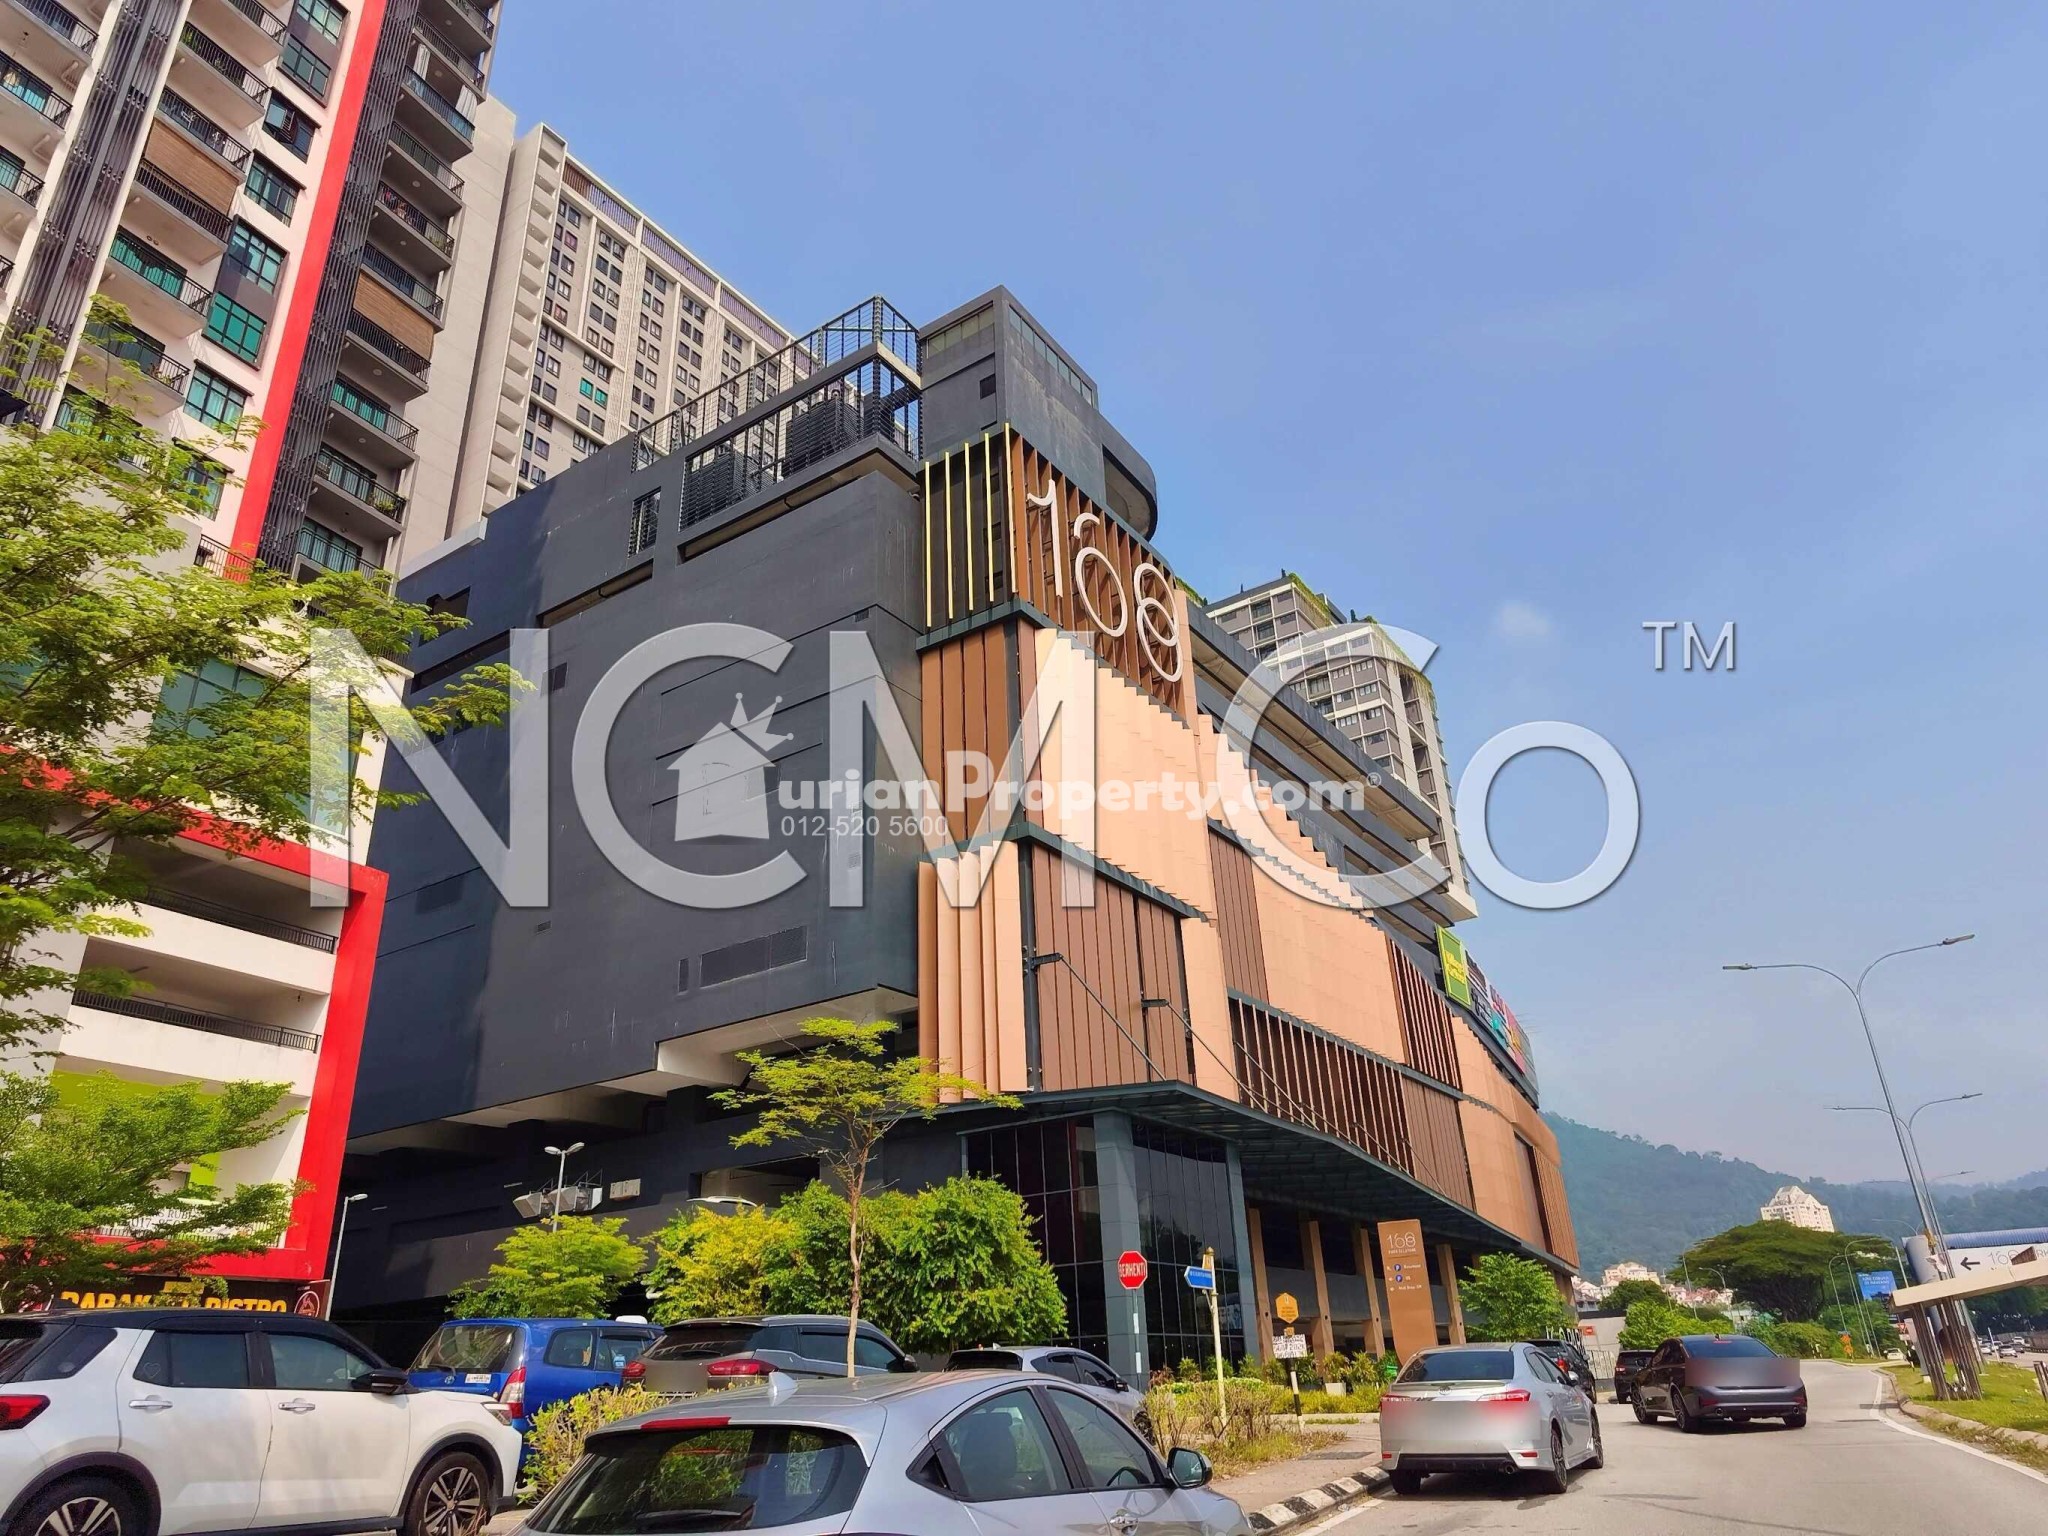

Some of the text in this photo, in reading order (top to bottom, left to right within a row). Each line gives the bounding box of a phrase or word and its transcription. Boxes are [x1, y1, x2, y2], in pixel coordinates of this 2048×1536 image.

[1026, 478, 1184, 683] 168
[1386, 1231, 1417, 1249] 168
[1118, 1262, 1146, 1278] BERHENTI
